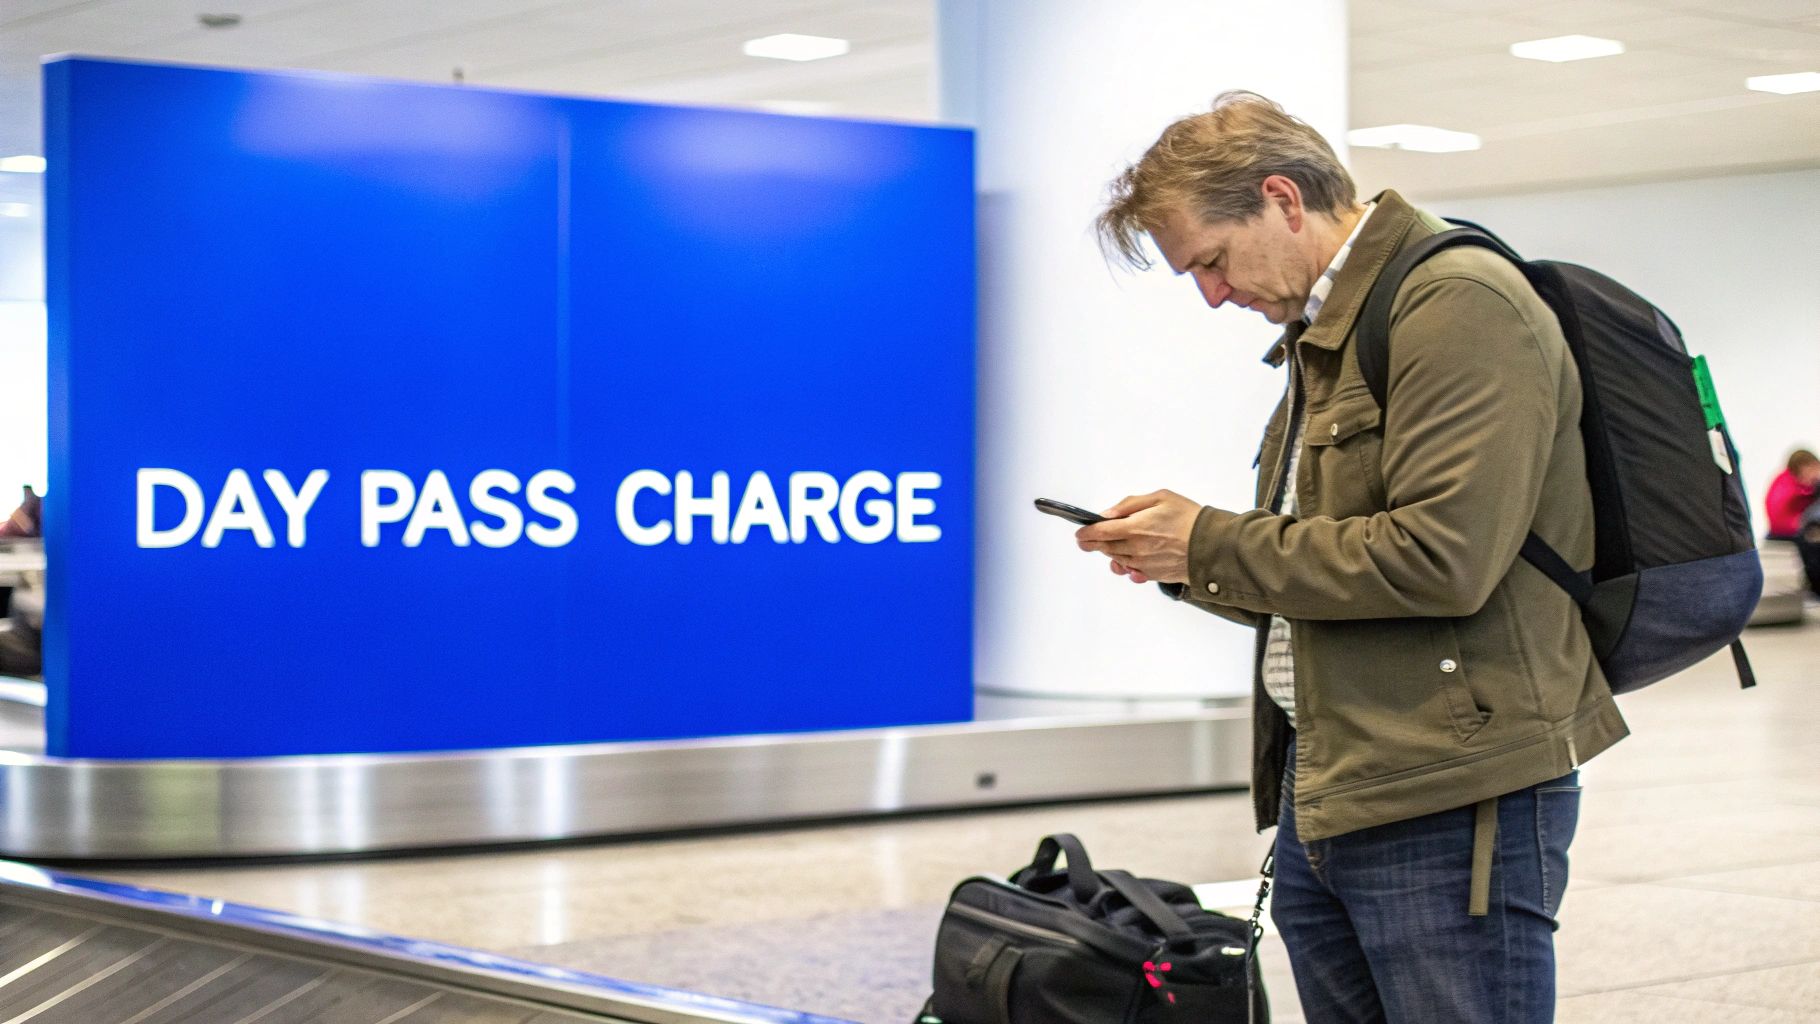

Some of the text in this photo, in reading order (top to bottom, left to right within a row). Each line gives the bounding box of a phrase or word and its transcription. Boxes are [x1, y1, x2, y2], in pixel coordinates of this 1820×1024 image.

[136, 467, 942, 549] DAY PASS CHARGE
